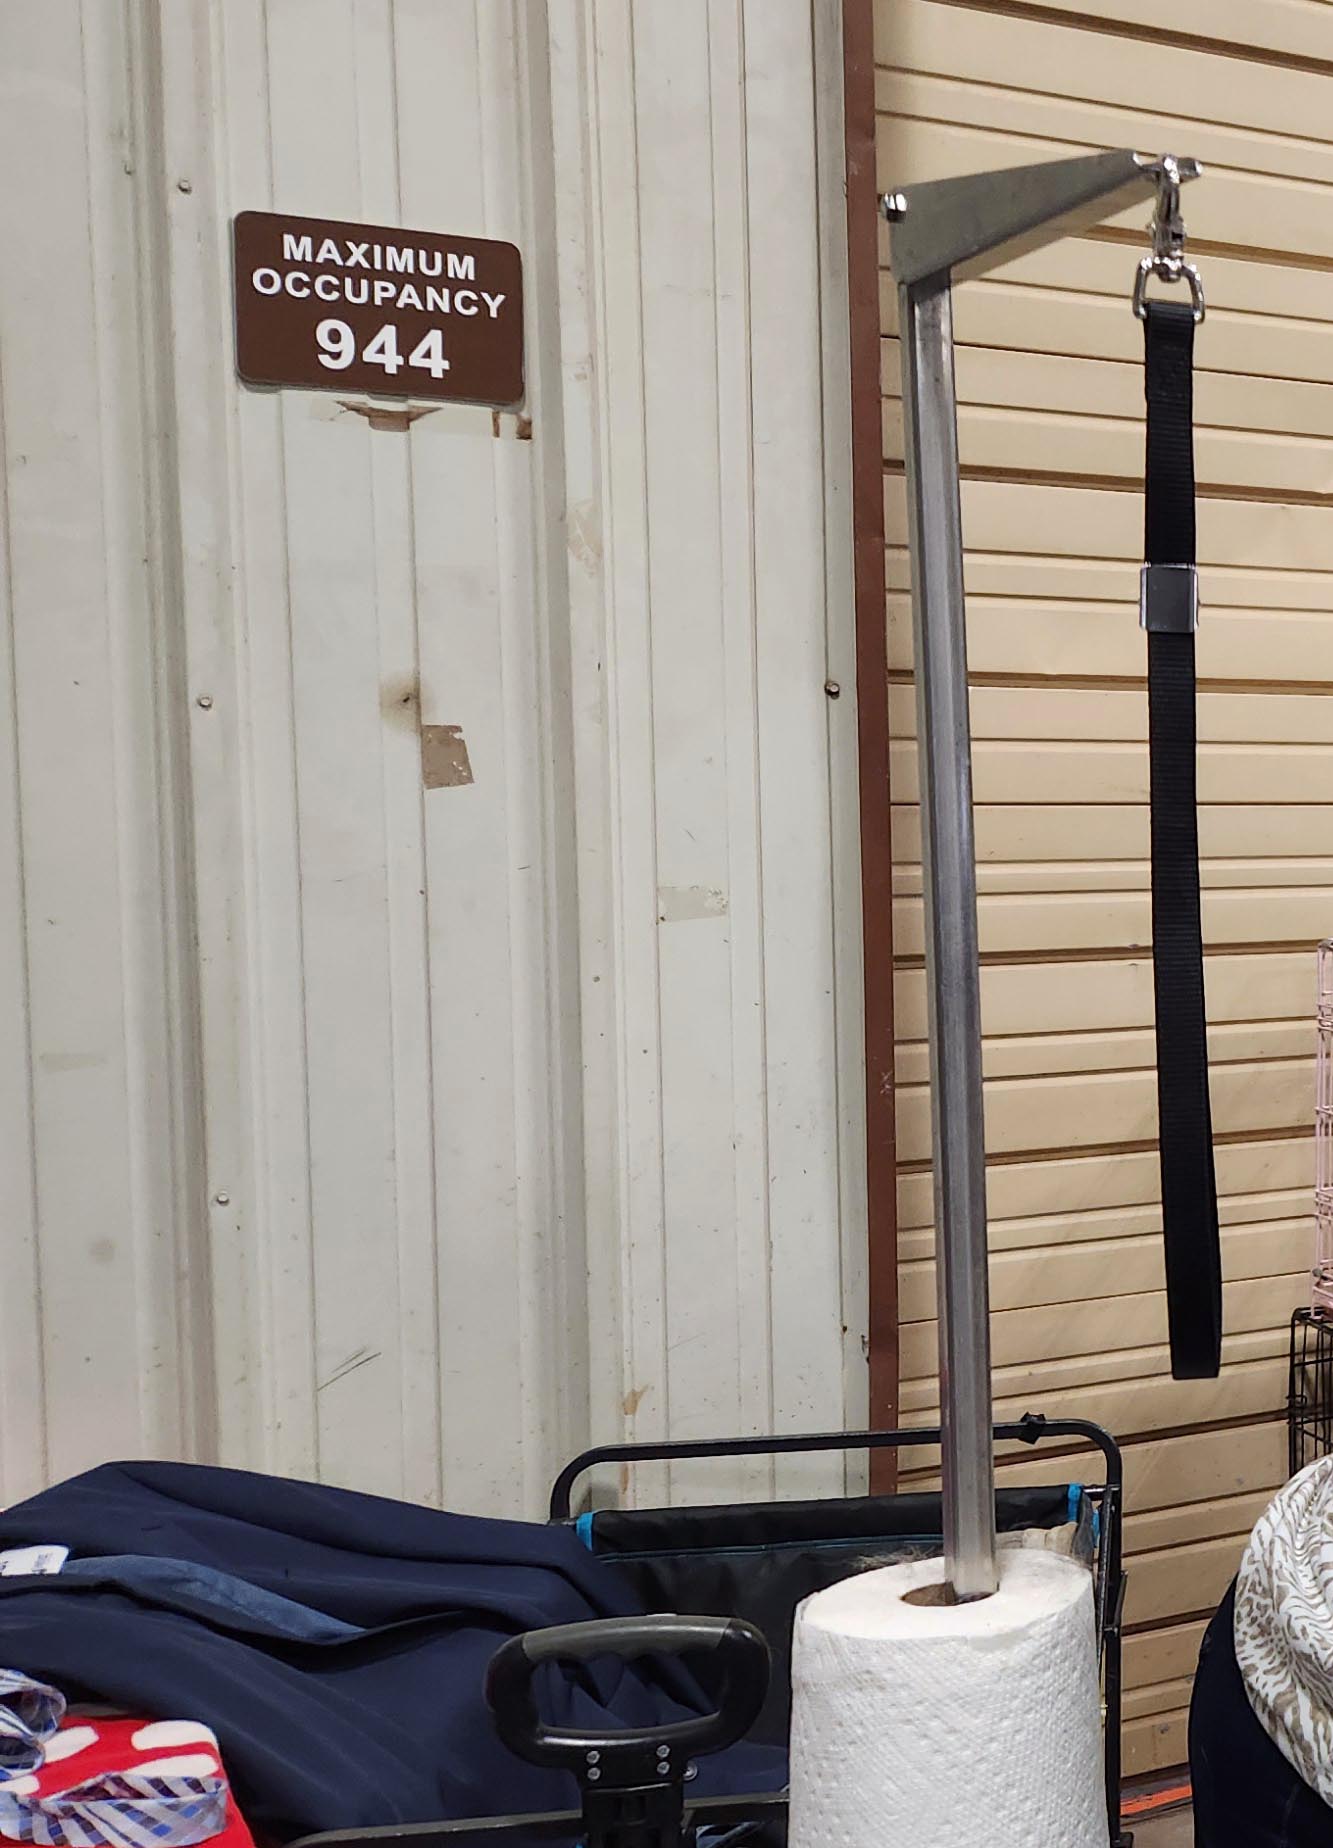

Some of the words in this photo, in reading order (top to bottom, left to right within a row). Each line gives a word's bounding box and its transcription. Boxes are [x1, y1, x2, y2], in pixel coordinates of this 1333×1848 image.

[282, 232, 476, 281] MAXIMUM
[252, 267, 506, 319] OCCUPANCY
[315, 318, 450, 379] 944
